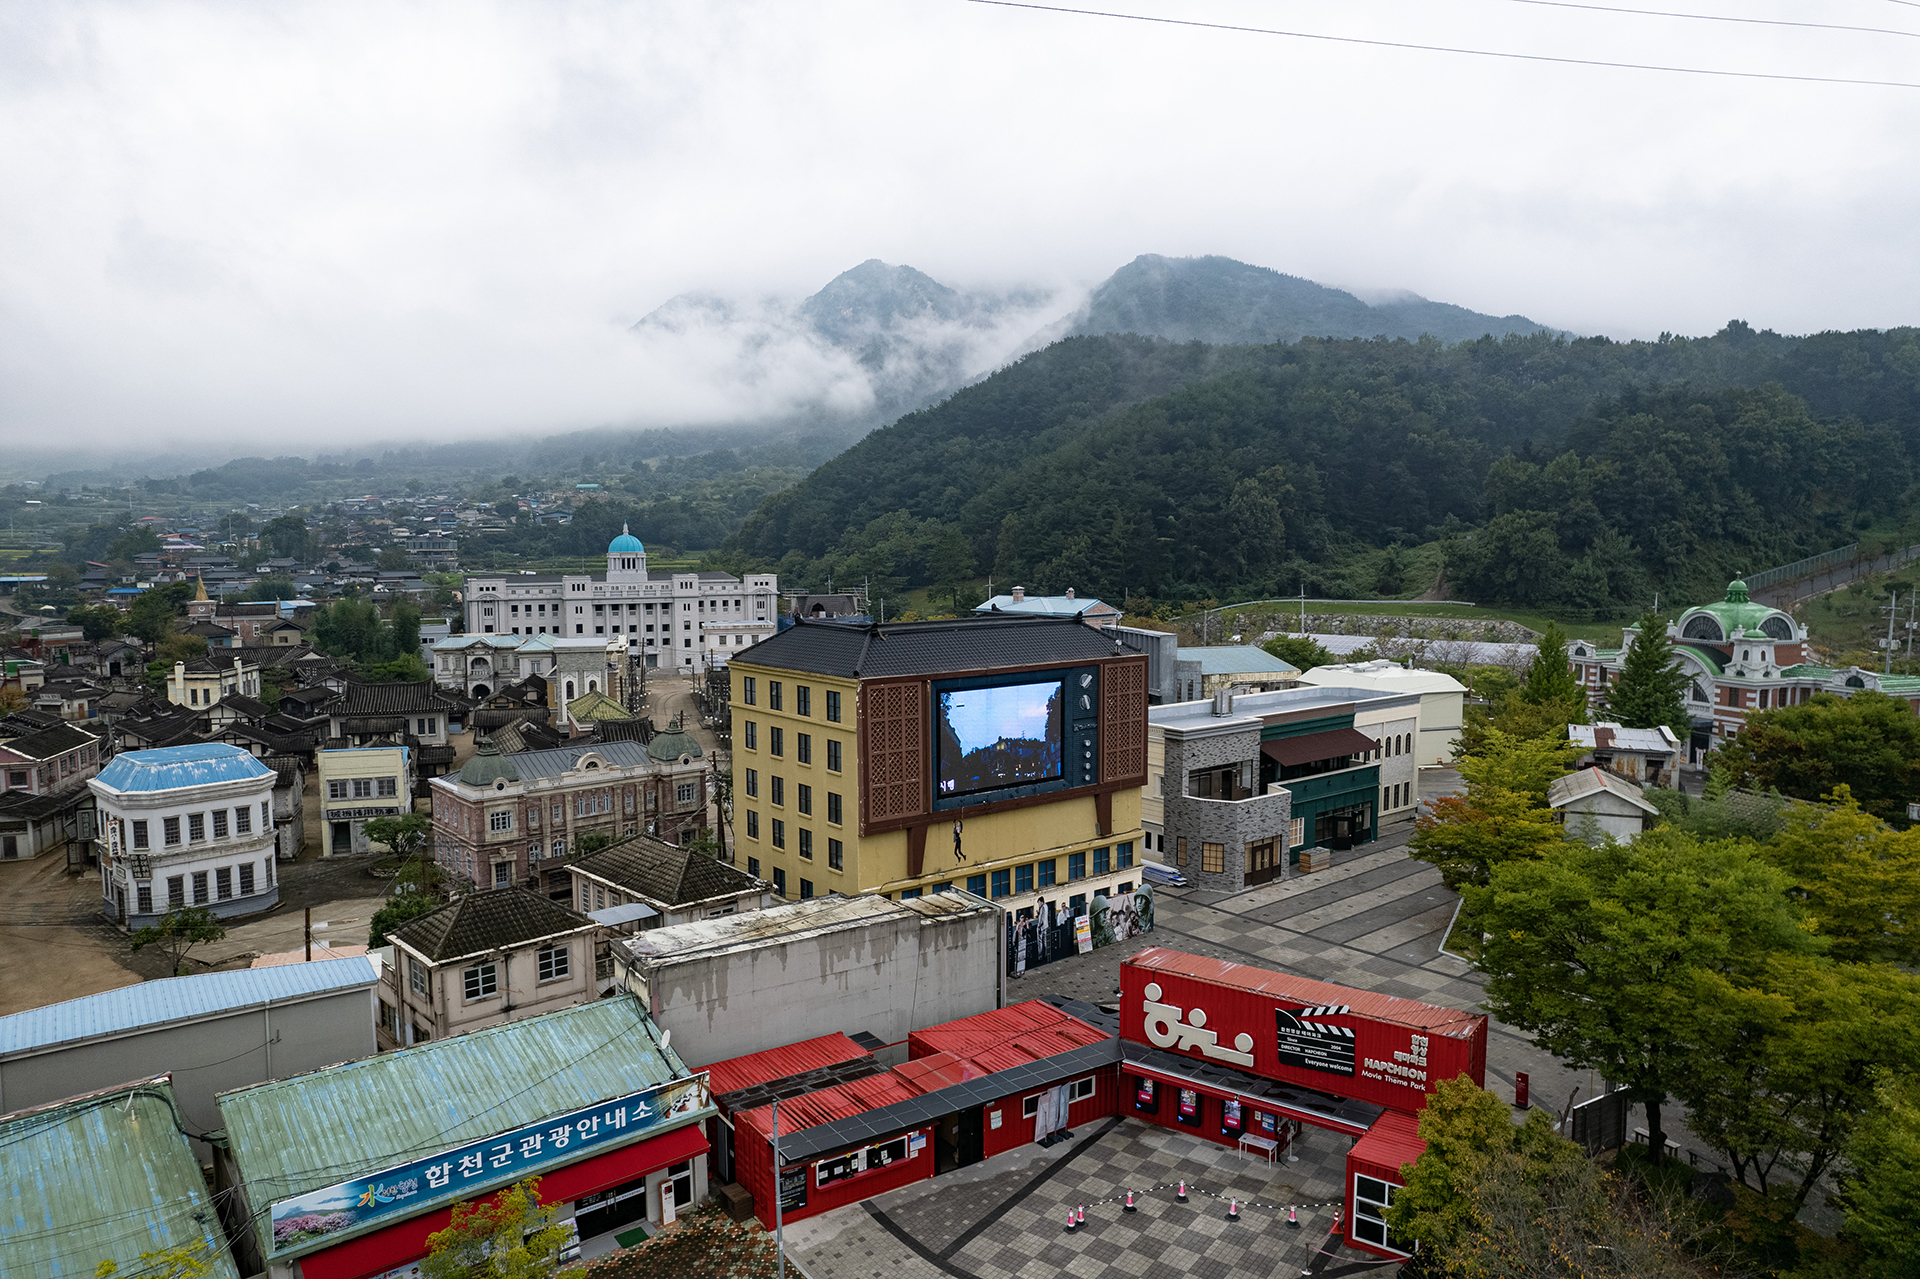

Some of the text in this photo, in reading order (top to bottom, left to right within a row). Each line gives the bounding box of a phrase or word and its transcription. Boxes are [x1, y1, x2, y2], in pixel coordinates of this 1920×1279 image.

[1411, 1034, 1428, 1048] 합천
[1280, 1044, 1328, 1057] DIRECTOR HAPCHEON
[1410, 1044, 1428, 1057] 영상
[1304, 1058, 1353, 1073] Everyone welcome
[1393, 1051, 1427, 1067] 테마파크
[1364, 1058, 1427, 1082] HAPCHEON
[1361, 1070, 1426, 1091] Movie Theme Park
[425, 1101, 653, 1189] 합천군관광안내소
